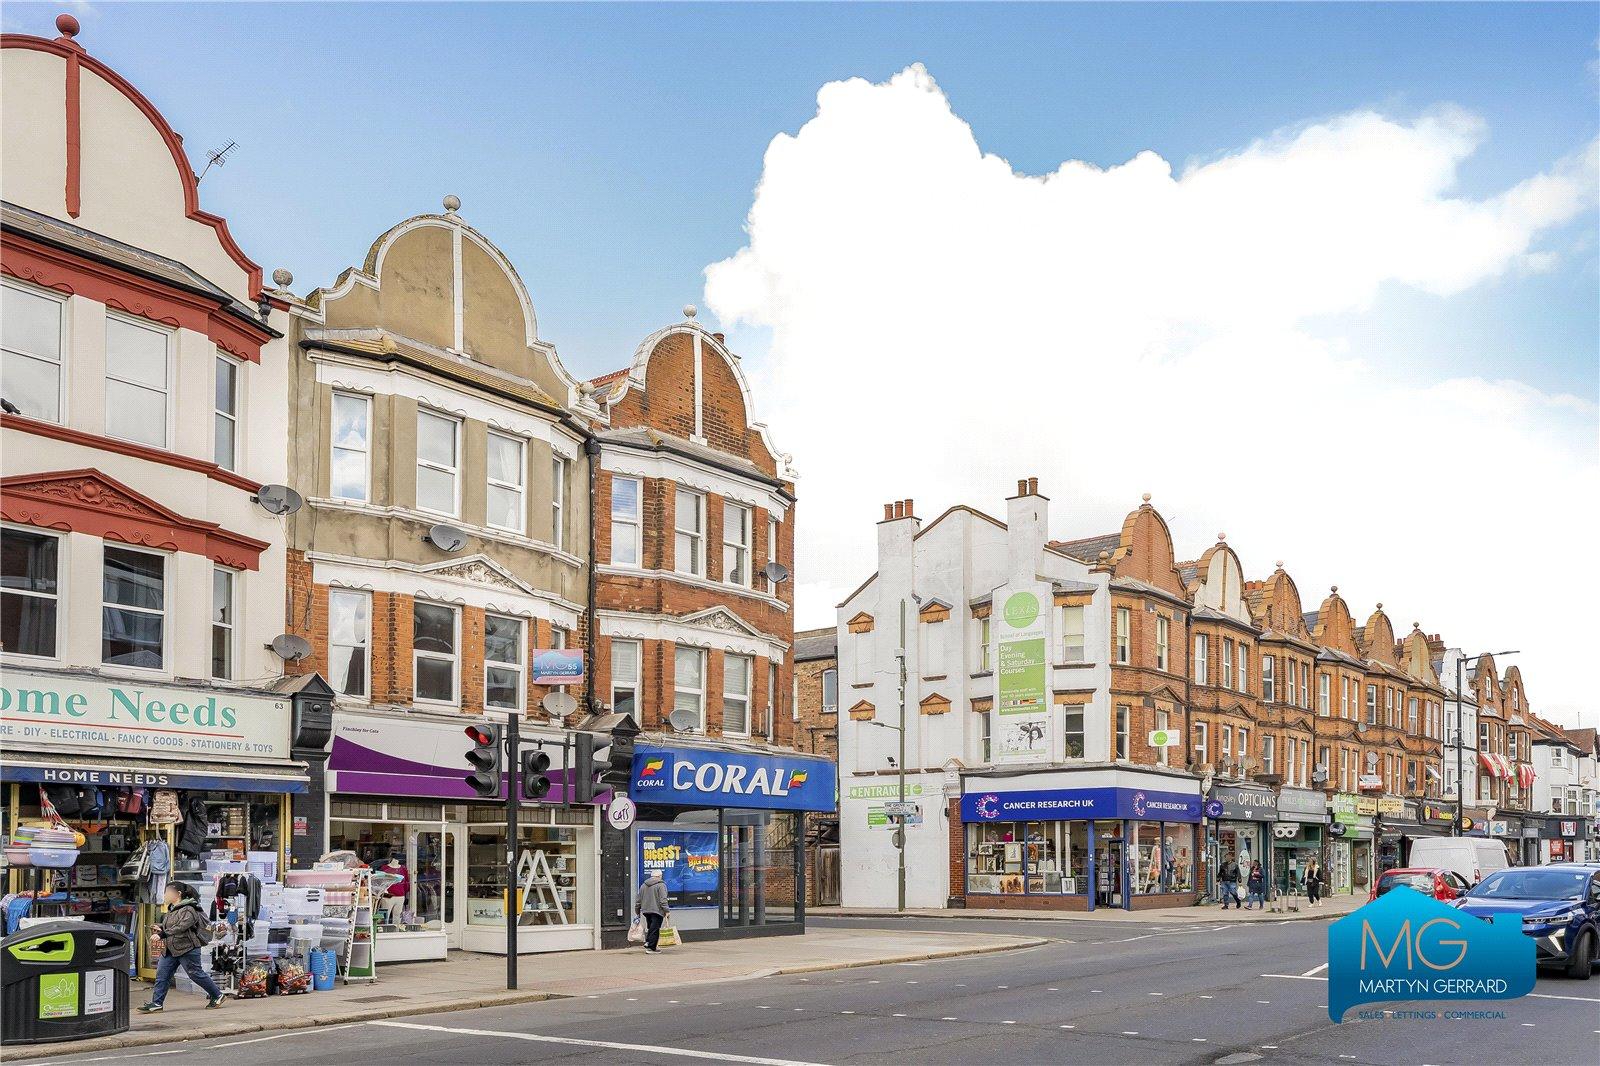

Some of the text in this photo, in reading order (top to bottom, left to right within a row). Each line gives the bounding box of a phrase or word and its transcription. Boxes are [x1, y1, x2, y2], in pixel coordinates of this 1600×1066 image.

[1000, 652, 1025, 660] Evening
[1007, 658, 1035, 667] Saturday
[1000, 667, 1025, 675] Courses
[107, 688, 236, 728] Needs
[274, 702, 285, 710] 63
[24, 727, 41, 737] DIY
[50, 728, 110, 742] ELECTRICAL
[117, 733, 149, 744] FANCY
[153, 737, 184, 747] GOODS
[191, 739, 243, 751] STATIONERY
[253, 744, 274, 753] TOYS
[44, 770, 169, 785] HOME NEEDS
[673, 761, 789, 796] CORAL
[637, 779, 665, 787] CORAL
[1238, 792, 1276, 808] OPTICIANS
[1003, 801, 1036, 810] CANCER
[1037, 800, 1080, 809] RESEARCH
[1146, 801, 1162, 809] CANCER
[1162, 802, 1180, 810] RESEARCH
[643, 841, 656, 850] OUR
[643, 845, 681, 861] BIGGEST
[643, 860, 674, 868] SPLASH YET
